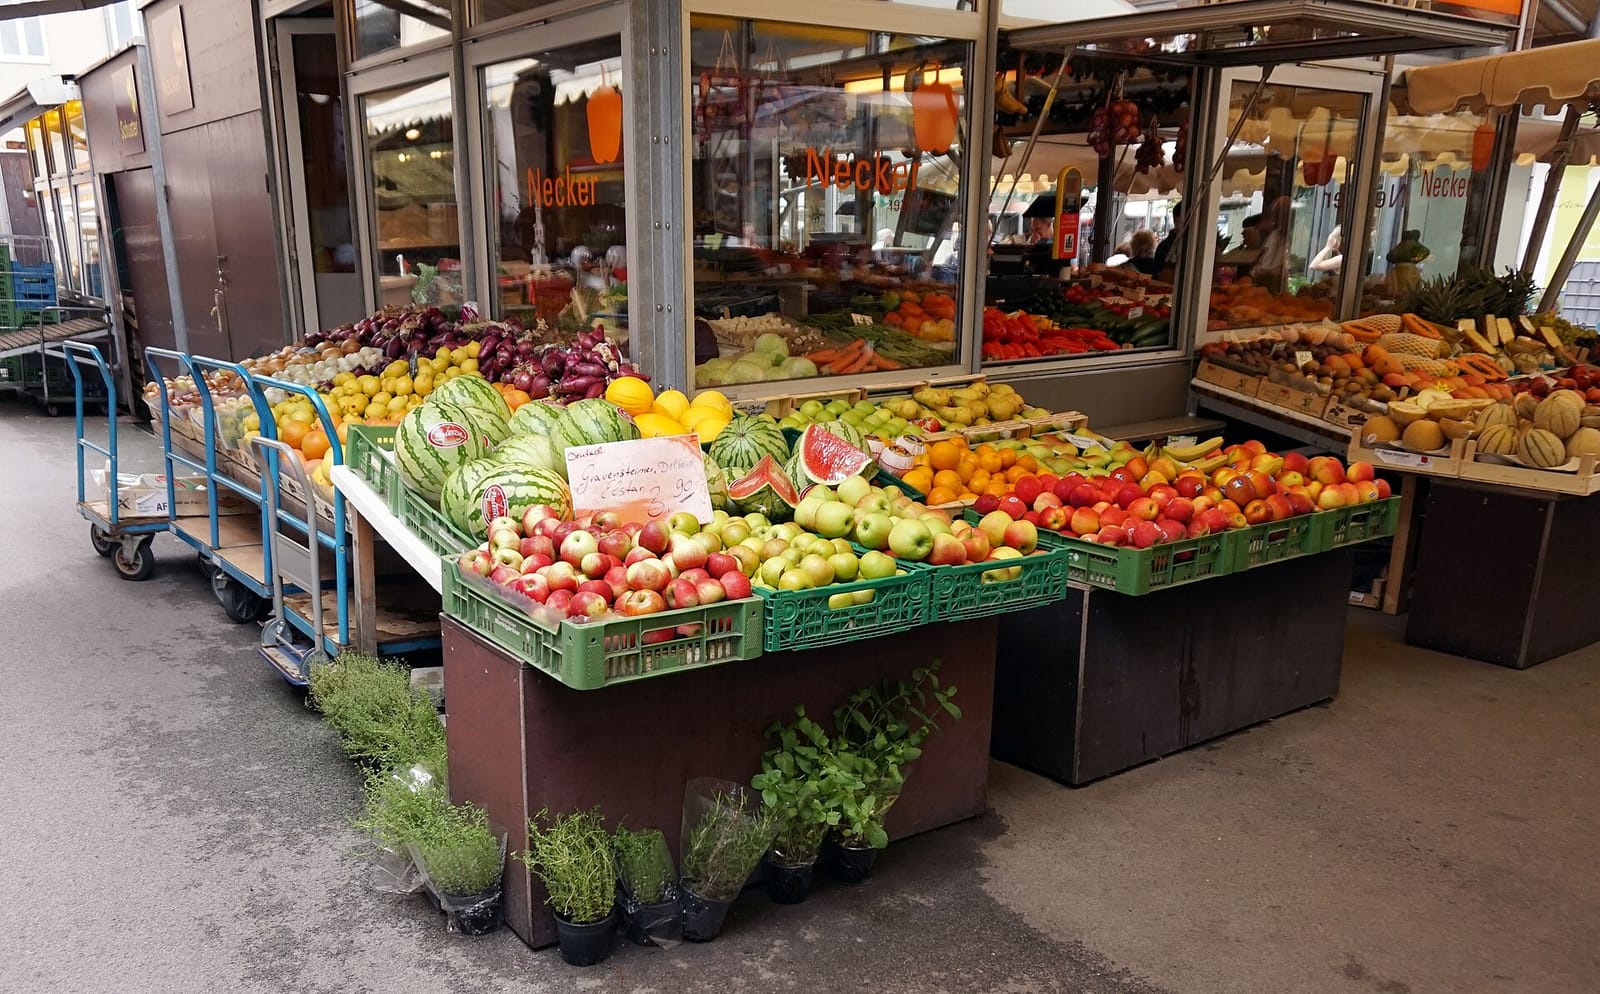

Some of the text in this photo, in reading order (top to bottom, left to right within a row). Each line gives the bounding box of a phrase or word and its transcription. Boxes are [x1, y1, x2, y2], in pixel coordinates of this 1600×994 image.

[806, 146, 922, 192] Necker
[527, 164, 599, 208] Necker
[600, 478, 645, 499] Elstar
[672, 478, 693, 498] 90
